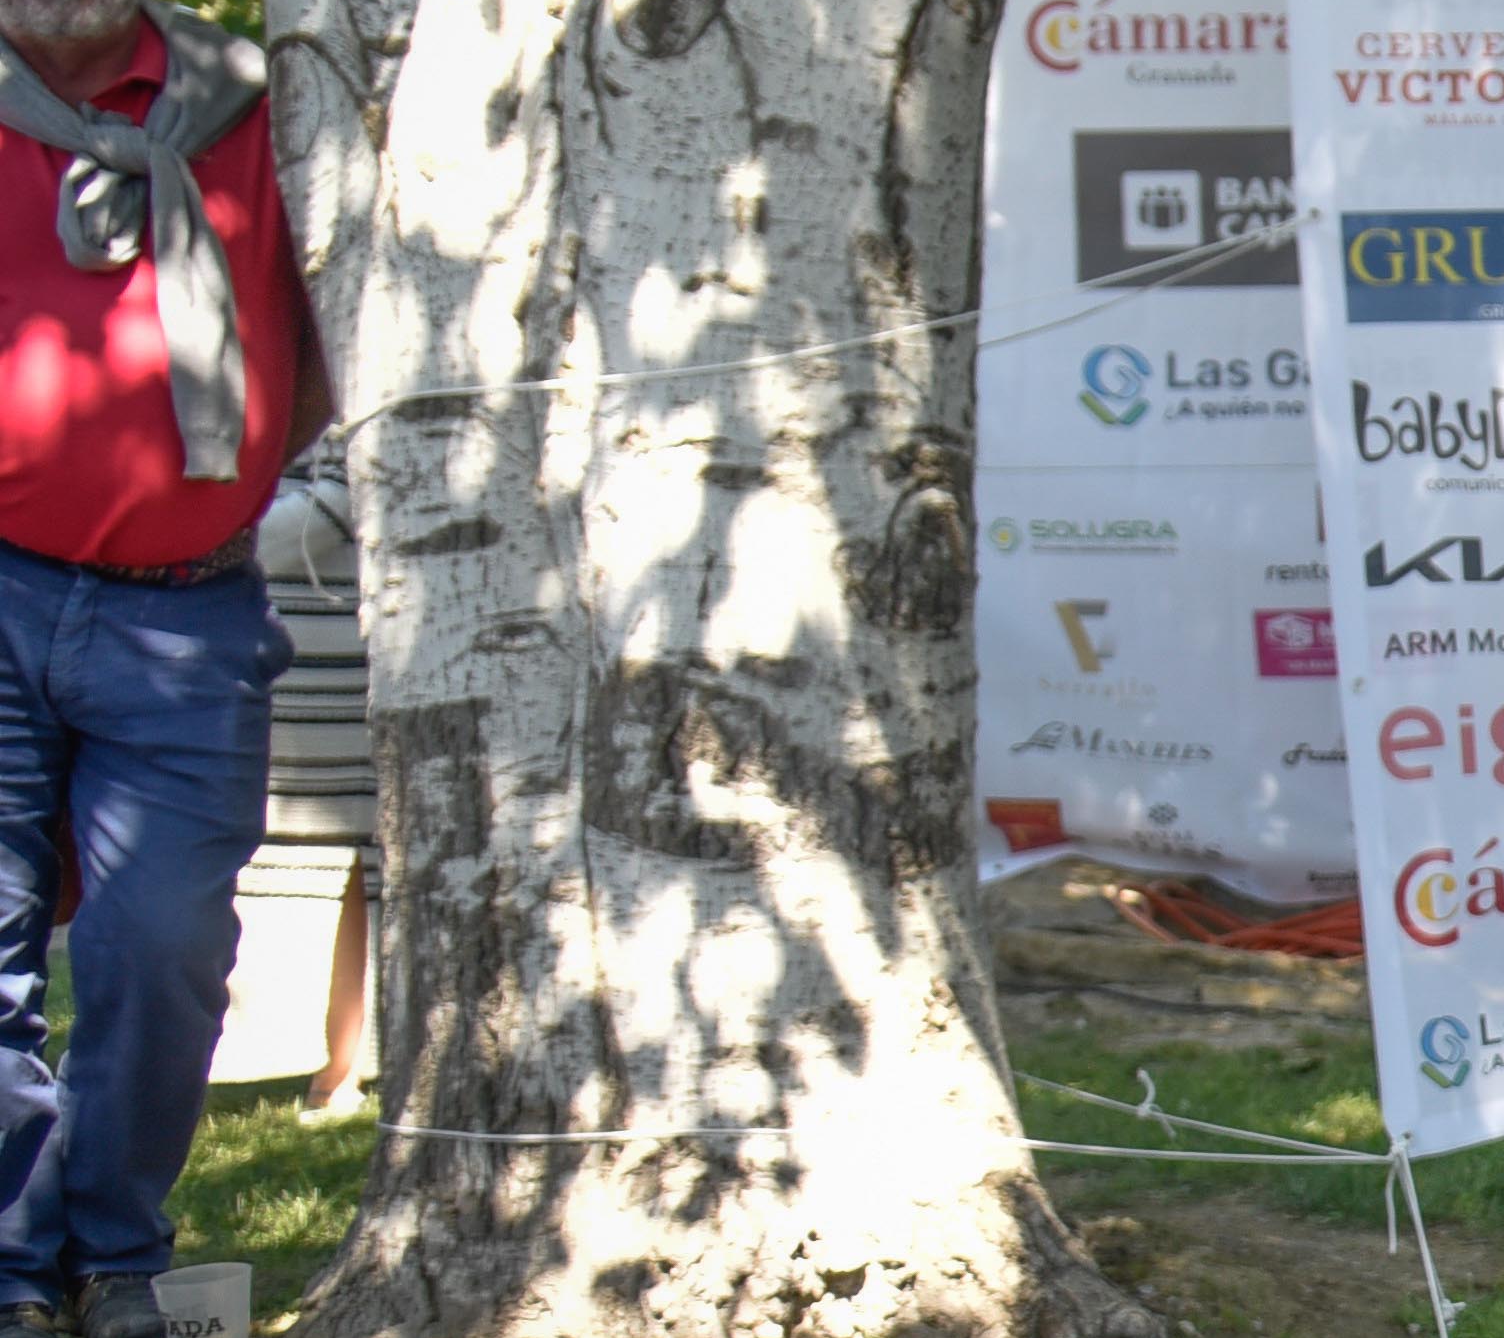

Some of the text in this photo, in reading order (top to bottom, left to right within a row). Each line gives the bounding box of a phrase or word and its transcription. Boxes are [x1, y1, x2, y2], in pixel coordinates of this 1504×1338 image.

[1165, 347, 1310, 390] Las G
[1384, 629, 1458, 660] ARM
